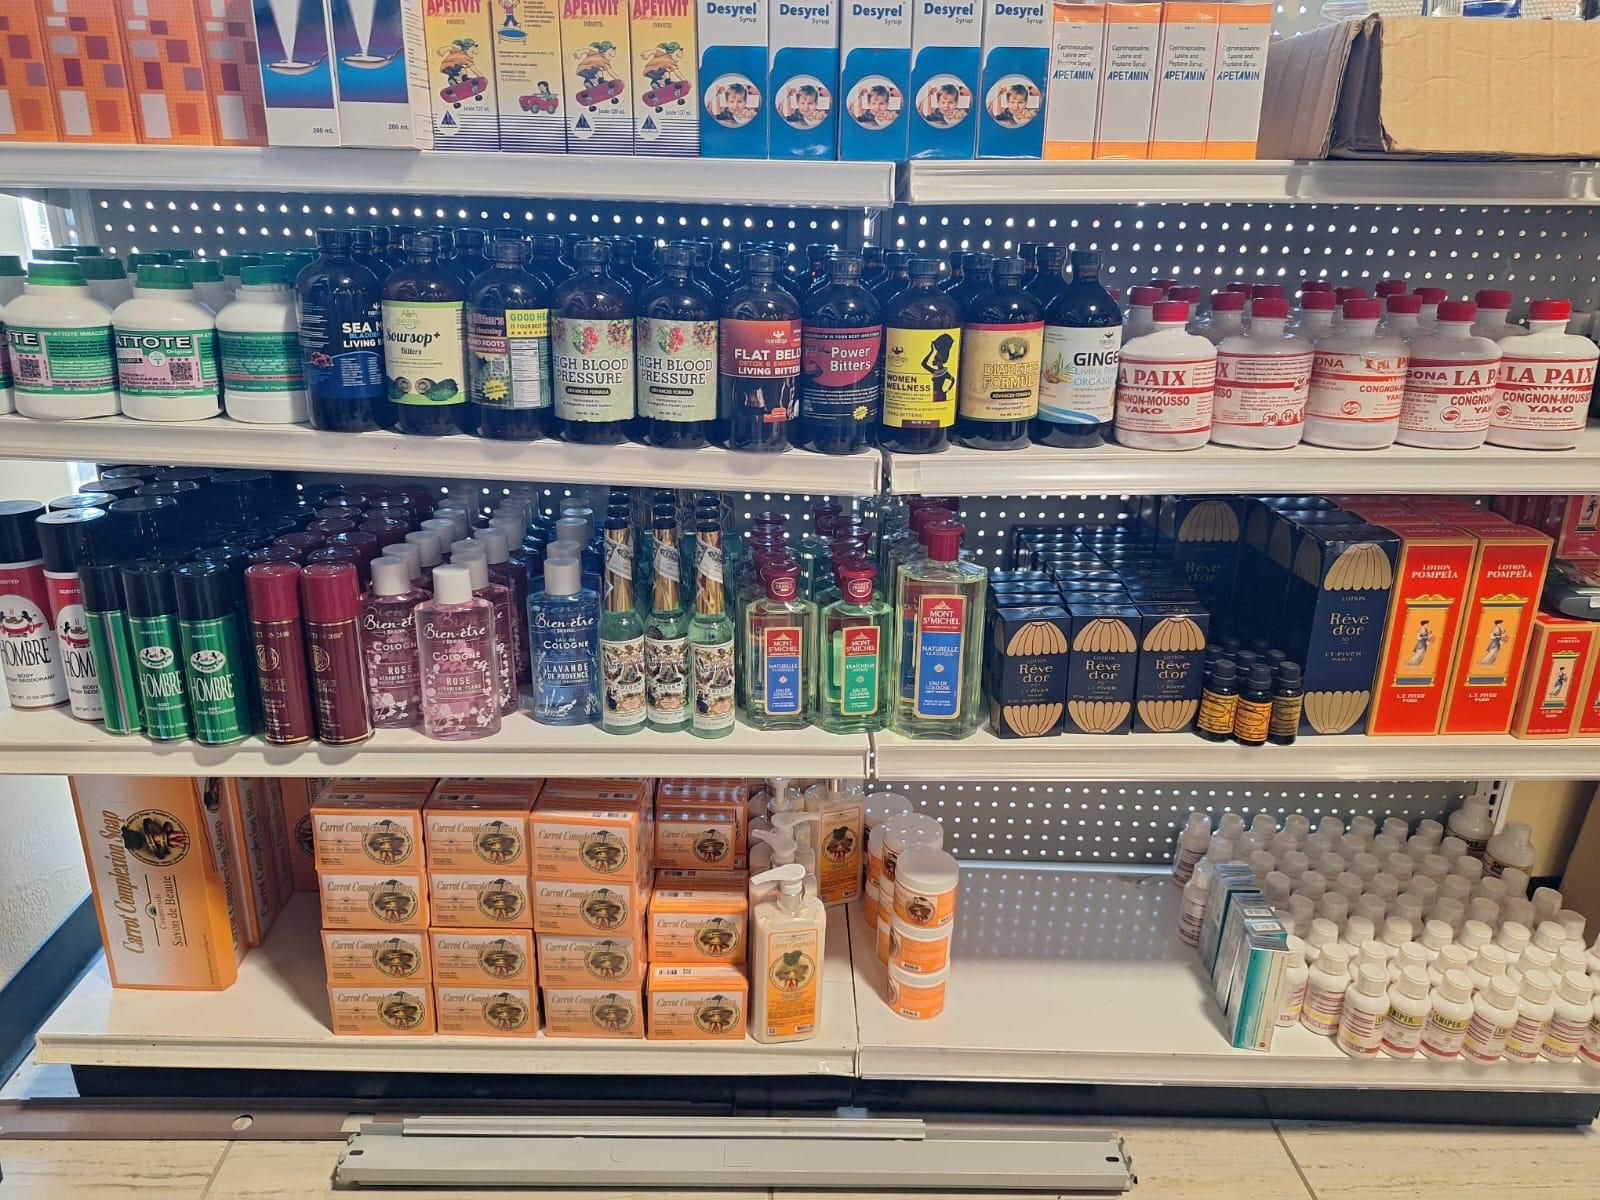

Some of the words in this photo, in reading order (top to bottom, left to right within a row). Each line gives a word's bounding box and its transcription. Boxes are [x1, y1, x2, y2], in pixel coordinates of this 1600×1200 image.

[707, 2, 756, 16] Desyrel
[779, 4, 829, 17] Desyrel
[852, 4, 902, 18] Desyrel
[924, 3, 974, 16] Desyrel
[995, 4, 1044, 17] Desyrel
[739, 16, 757, 24] Syrup
[812, 18, 829, 26] Syrup
[884, 18, 902, 26] Syrup
[955, 17, 973, 25] Syrup
[1026, 17, 1043, 25] Syrup
[1053, 70, 1093, 80] APETAMIN
[1107, 71, 1149, 80] APETAMIN
[1164, 70, 1205, 80] APETAMIN
[1217, 71, 1259, 80] APETAMIN
[511, 313, 534, 321] GOOD
[342, 322, 372, 333] SEA
[343, 340, 376, 348] LIVING
[735, 348, 770, 360] FLAT
[831, 346, 870, 358] Power
[582, 358, 628, 371] BLOOD
[666, 359, 713, 372] BLOOD
[830, 360, 870, 372] Bitters
[738, 367, 770, 375] LIVING
[1506, 366, 1536, 383] LA
[1544, 367, 1594, 384] PAIX
[557, 370, 622, 384] PRESSURE
[641, 369, 706, 385] PRESSURE
[887, 375, 917, 383] WOMEN
[1134, 370, 1187, 386] PAIX
[1453, 370, 1480, 386] LA
[887, 382, 930, 392] WELLNESS
[1124, 406, 1163, 415] YAKO
[535, 613, 594, 628] Bien-être
[1329, 612, 1369, 625] Rêve
[424, 623, 486, 638] Bien-être
[1332, 625, 1364, 636] d'or
[373, 642, 416, 651] COLOGN
[543, 640, 589, 649] COLOGNE
[0, 638, 52, 666] HOMBRE
[432, 651, 480, 661] COLOGNE
[388, 665, 412, 674] ROSE
[546, 663, 588, 673] LAVANDE
[1019, 664, 1053, 674] Rêve
[1086, 660, 1121, 671] Rêve
[1156, 660, 1191, 671] Rêve
[446, 676, 471, 685] ROSE
[557, 671, 588, 680] PROVENCE
[141, 670, 184, 698] HOMBRE
[191, 674, 234, 702] HOMBRE
[99, 810, 125, 843] Soap
[320, 822, 345, 832] Carrot
[432, 822, 454, 833] Carrot
[538, 829, 562, 840] Carrot
[104, 843, 138, 914] Complexion
[328, 881, 351, 892] Carrot
[436, 880, 458, 890] Carrot
[540, 888, 563, 898] Carrot
[167, 910, 178, 921] de
[657, 919, 678, 928] Carrot
[121, 913, 145, 954] Carrot
[170, 924, 185, 946] Savon
[331, 940, 355, 950] Carrot
[438, 940, 461, 950] Carrot
[545, 942, 568, 952] Carrot
[338, 993, 359, 1002] Carrot
[442, 993, 466, 1002] Carrot
[552, 995, 575, 1004] Carrot
[656, 999, 680, 1007] Carrot
